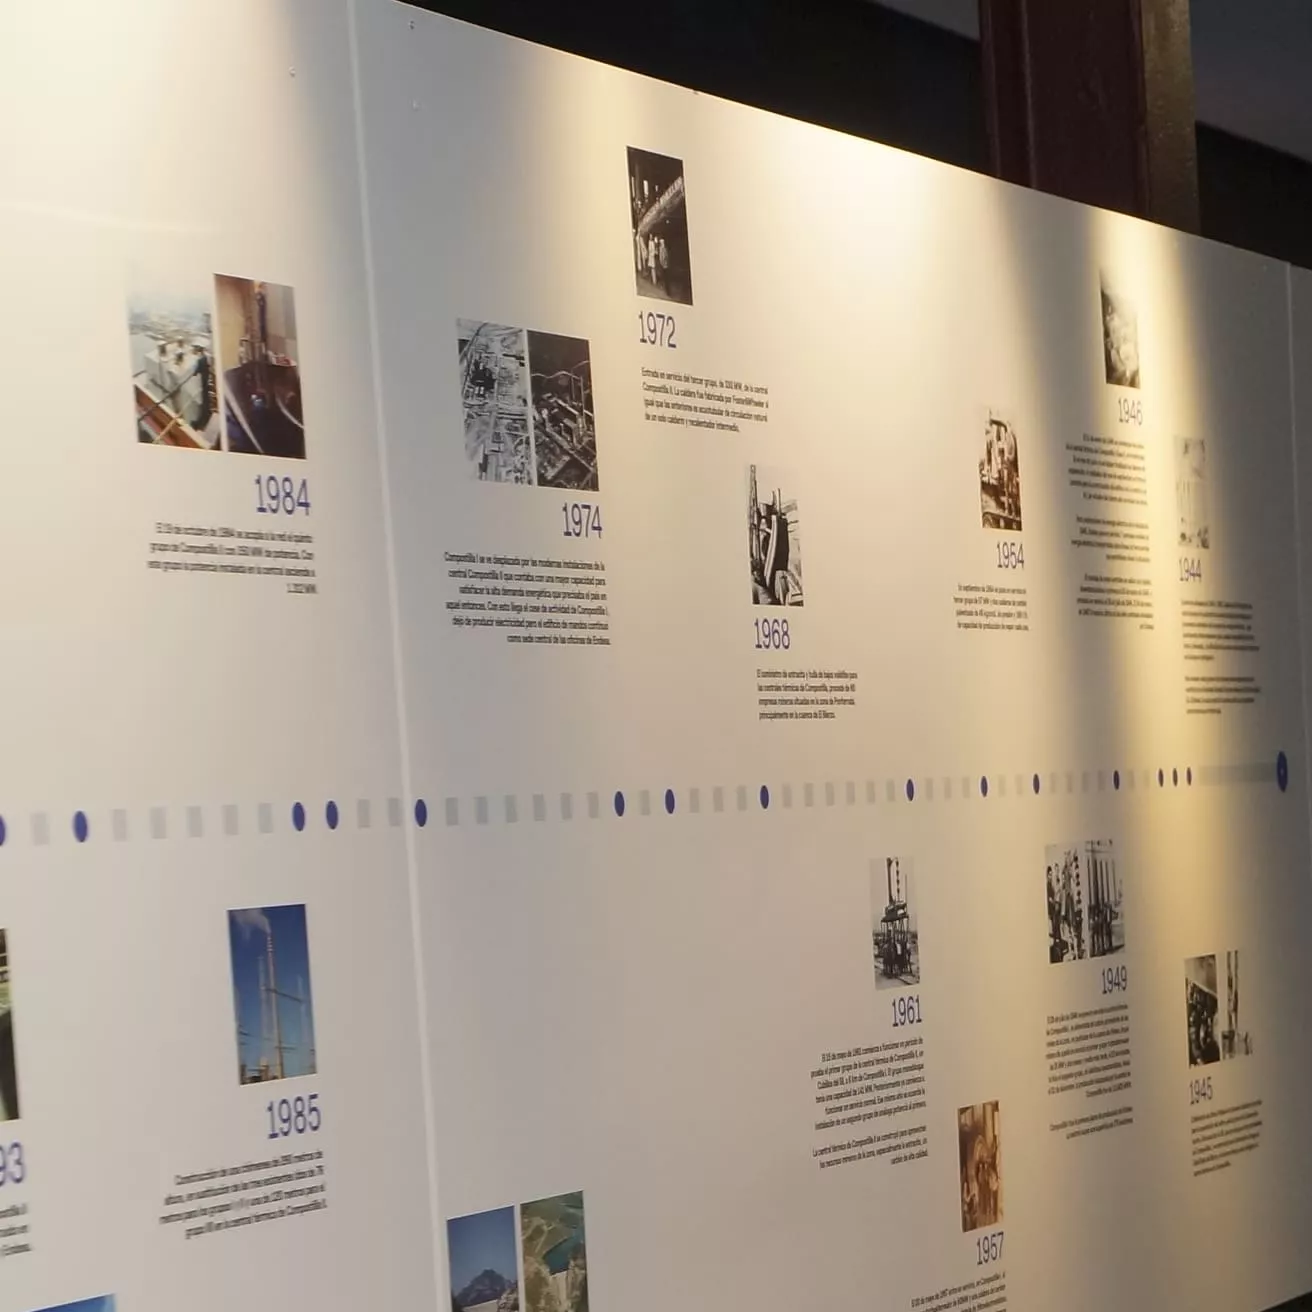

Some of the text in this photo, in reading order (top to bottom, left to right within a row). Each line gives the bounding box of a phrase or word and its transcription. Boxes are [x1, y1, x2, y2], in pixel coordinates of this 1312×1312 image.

[639, 311, 677, 348] 1972
[1118, 398, 1143, 425] 1946
[255, 474, 311, 516] 1984
[562, 502, 602, 538] 1974
[997, 541, 1025, 570] 1954
[1178, 557, 1202, 582] 1944
[754, 618, 790, 649] 1968
[1102, 965, 1128, 994] 1949
[892, 994, 922, 1027] 1961
[1189, 1076, 1214, 1105] 1945
[266, 1093, 322, 1139] 1985
[976, 1231, 1004, 1266] 1957
